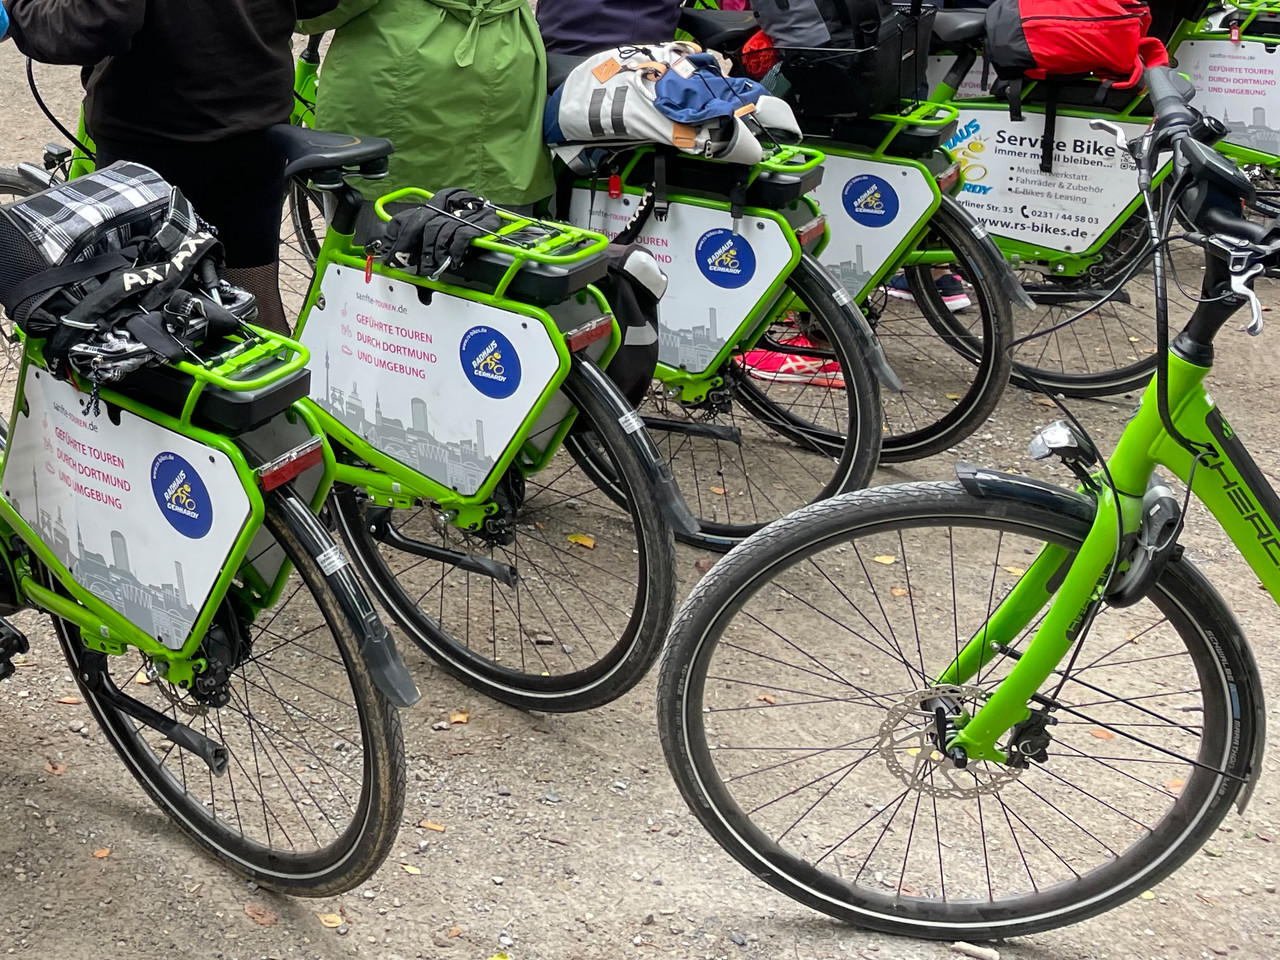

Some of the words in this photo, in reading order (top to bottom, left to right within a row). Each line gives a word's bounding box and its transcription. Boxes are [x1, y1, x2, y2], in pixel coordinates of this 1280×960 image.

[1208, 65, 1243, 74] GEFÜHRTE
[1244, 67, 1274, 75] TOUREN
[1233, 78, 1277, 86] DORTMUND
[1224, 88, 1266, 96] UMGEBUNG
[994, 146, 1027, 158] immer
[1030, 153, 1060, 162] mil
[995, 130, 1067, 152] Serve
[1073, 139, 1116, 157] Bike
[853, 183, 878, 207] RADHAUS
[1014, 187, 1044, 198] E-Bikes
[1054, 192, 1087, 204] Leasing
[1015, 176, 1056, 189] Fahrräder
[1058, 181, 1065, 189] &
[1066, 182, 1104, 194] Zubehör
[958, 200, 984, 210] erliner
[986, 203, 1001, 212] Str.
[1003, 205, 1014, 214] 35
[1031, 210, 1053, 219] 0231
[1061, 213, 1072, 221] 44
[1075, 215, 1086, 223] 58
[1087, 216, 1099, 224] 03
[977, 216, 1088, 239] www.rs-bikes.de
[635, 235, 669, 247] OUREN
[707, 239, 734, 265] RADHAUS
[355, 292, 408, 315] sanfte-TOUREN.de
[356, 313, 394, 335] GEFÜHRTE
[394, 326, 433, 344] TOUREN
[356, 331, 381, 349] DURCH
[382, 341, 437, 364] DORTMUND
[471, 339, 498, 369] RADHAUS
[357, 350, 373, 364] UND
[373, 357, 426, 380] UMGEBUNG
[55, 426, 88, 456] GEFÜHRTE
[87, 445, 125, 470] TOUREN
[56, 447, 77, 471] DURCH
[78, 462, 131, 492] DORTMUND
[58, 469, 72, 487] UND
[72, 480, 122, 510] UMGEBUNG
[163, 469, 187, 502] RADHAUS
[1204, 630, 1235, 682] SCHWALBE
[1228, 720, 1241, 769] MARATHON
